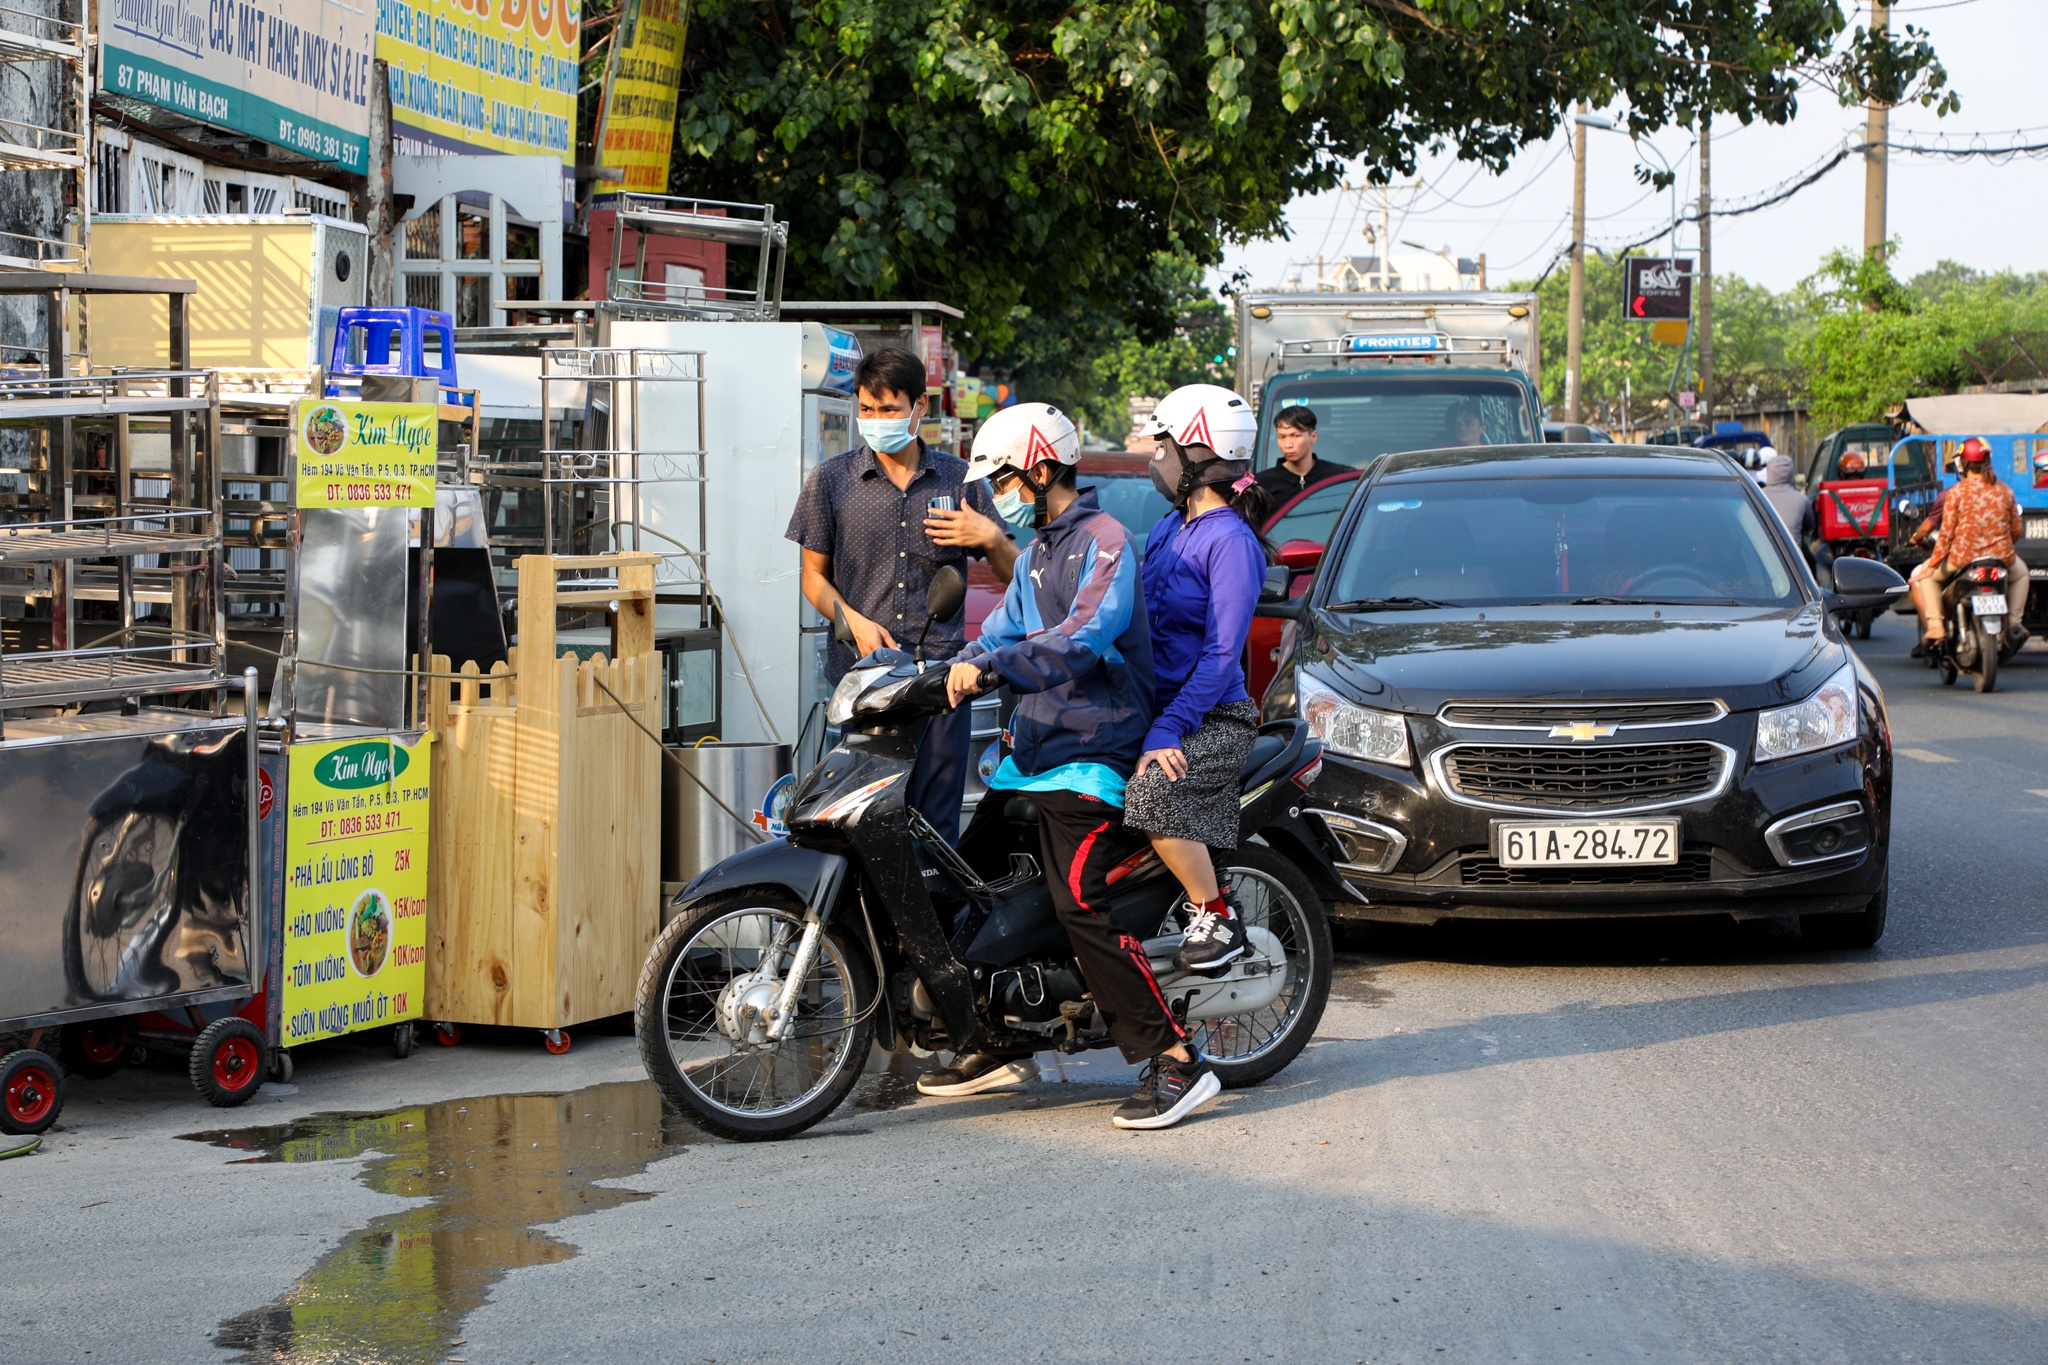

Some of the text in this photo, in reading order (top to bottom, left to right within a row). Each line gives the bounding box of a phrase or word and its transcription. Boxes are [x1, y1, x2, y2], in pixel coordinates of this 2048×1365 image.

[267, 3, 299, 82] HÀNG
[301, 30, 328, 92] INOX
[343, 48, 352, 102] &
[416, 10, 432, 52] GIA
[434, 12, 458, 61] CÔNG
[460, 22, 478, 67] CÁC
[480, 34, 498, 82] LOẠI
[118, 64, 228, 121] 87 PHẠM VĂN BẠCH
[461, 90, 485, 137] DỤNG
[491, 99, 507, 139] LAN
[510, 104, 525, 142] CAN
[544, 114, 568, 152] THANG
[280, 119, 360, 166] ĐT: 0903 381 517
[1639, 289, 1681, 297] COFFEE
[1359, 336, 1432, 348] FRONTIER
[351, 413, 432, 455] Kim Ngọc
[302, 462, 318, 476] Hẻm
[321, 463, 333, 476] 194
[336, 464, 344, 476] Võ
[346, 463, 360, 476] Văn
[409, 464, 435, 477] TP.HCM
[327, 484, 412, 501] ĐT: 0836 533 471
[329, 751, 391, 782] Kim Ngọ
[293, 802, 308, 818] Hẻm
[311, 800, 323, 815] 194
[325, 799, 334, 813] Võ
[336, 797, 350, 812] Văn
[402, 786, 429, 803] TP.HCM
[321, 811, 400, 838] ĐT: 0836 533 471
[1507, 828, 1669, 861] 61A-284.72
[295, 849, 411, 888] PHÁ LẤU LÒNG BÒ 25K
[294, 896, 426, 938] HÀO NƯỚNG 15K/con
[293, 960, 311, 987] TÔM
[315, 953, 345, 983] NƯỚNG
[393, 944, 425, 967] 10K/con
[291, 1005, 315, 1038] SƯỜN
[319, 1002, 349, 1032] NƯỚNG
[352, 991, 374, 1024] MUỐI
[377, 992, 388, 1019] ỚT
[393, 992, 408, 1015] 10K
